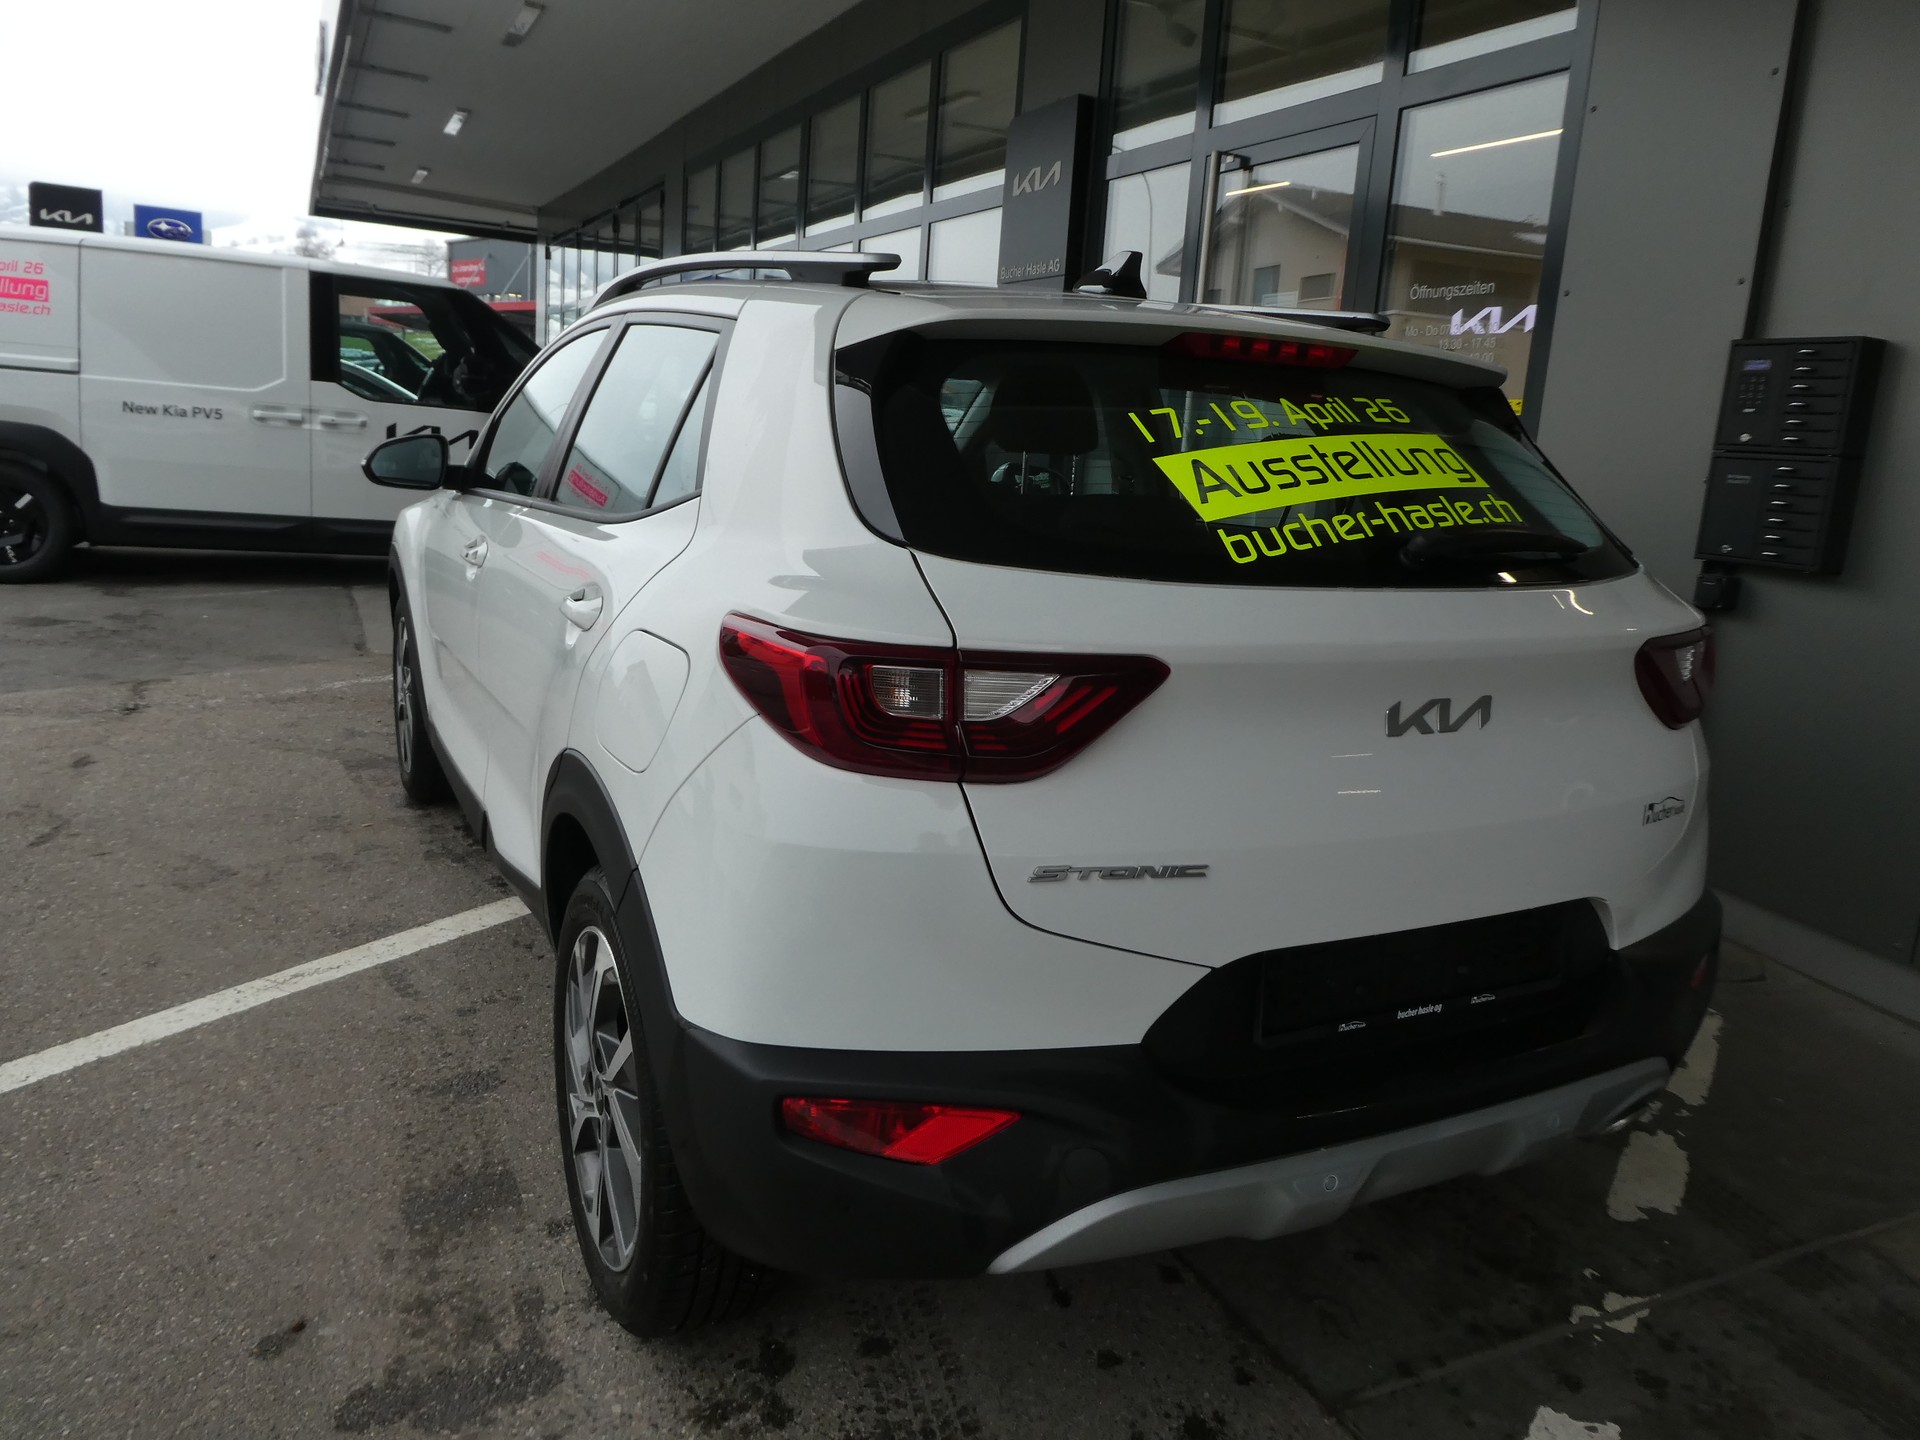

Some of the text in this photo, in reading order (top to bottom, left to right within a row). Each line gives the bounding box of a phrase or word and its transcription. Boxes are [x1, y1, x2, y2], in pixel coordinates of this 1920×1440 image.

[1012, 160, 1062, 197] KIA
[39, 208, 93, 225] KIA
[23, 261, 44, 275] 26
[1000, 258, 1060, 279] Bucher Hasle AG
[1410, 280, 1495, 300] Öffnungszeiten
[1425, 324, 1438, 336] Do
[1449, 304, 1538, 336] KIA
[121, 400, 223, 420] New Kia PV5
[1279, 397, 1361, 430] April
[1352, 397, 1411, 423] 26
[1190, 440, 1477, 504] Ausstellung
[1216, 494, 1523, 564] bucher-hasle.ch
[1384, 694, 1492, 737] KIA
[1029, 863, 1209, 884] STONIC
